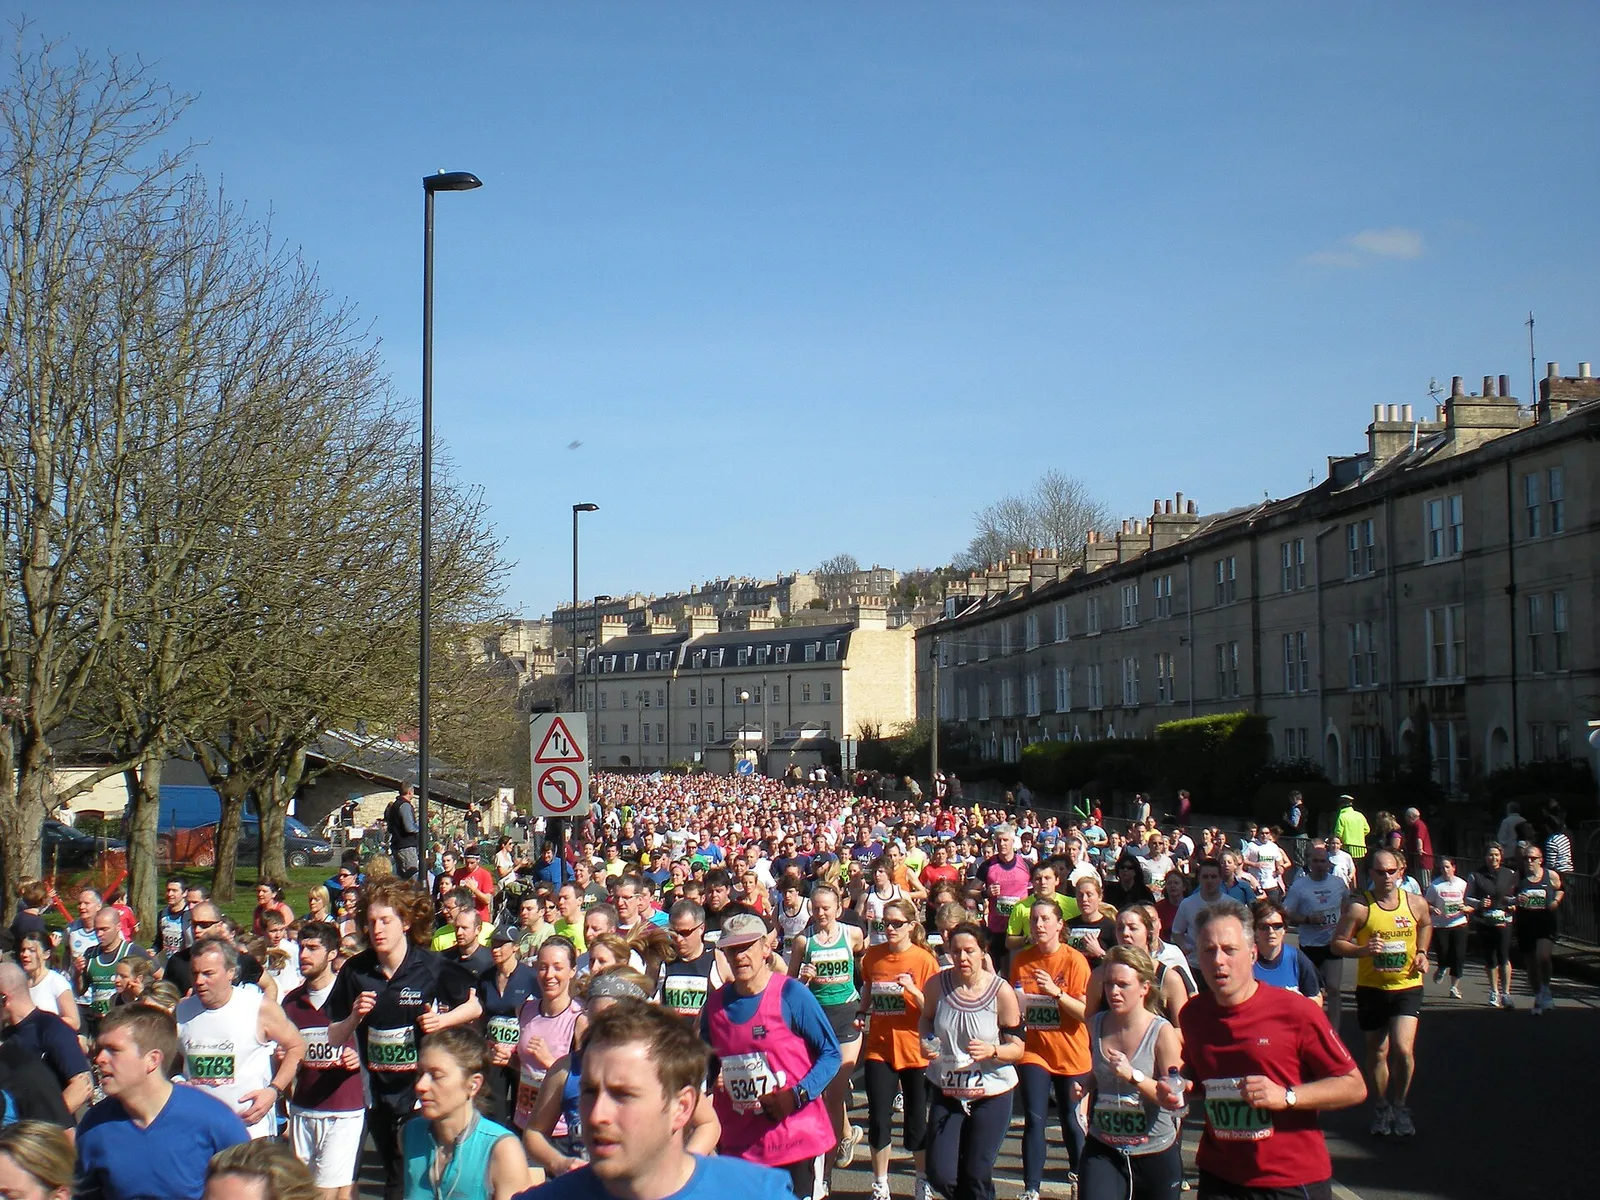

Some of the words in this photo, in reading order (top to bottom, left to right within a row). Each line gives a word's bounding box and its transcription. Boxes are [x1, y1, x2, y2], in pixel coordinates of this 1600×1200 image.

[815, 960, 849, 976] 12998
[667, 989, 706, 1006] 11677
[308, 1042, 343, 1060] 6087
[195, 1056, 235, 1076] 6783
[731, 1075, 767, 1100] 5347
[946, 1070, 984, 1088] 2772
[1232, 1129, 1271, 1139] balance
